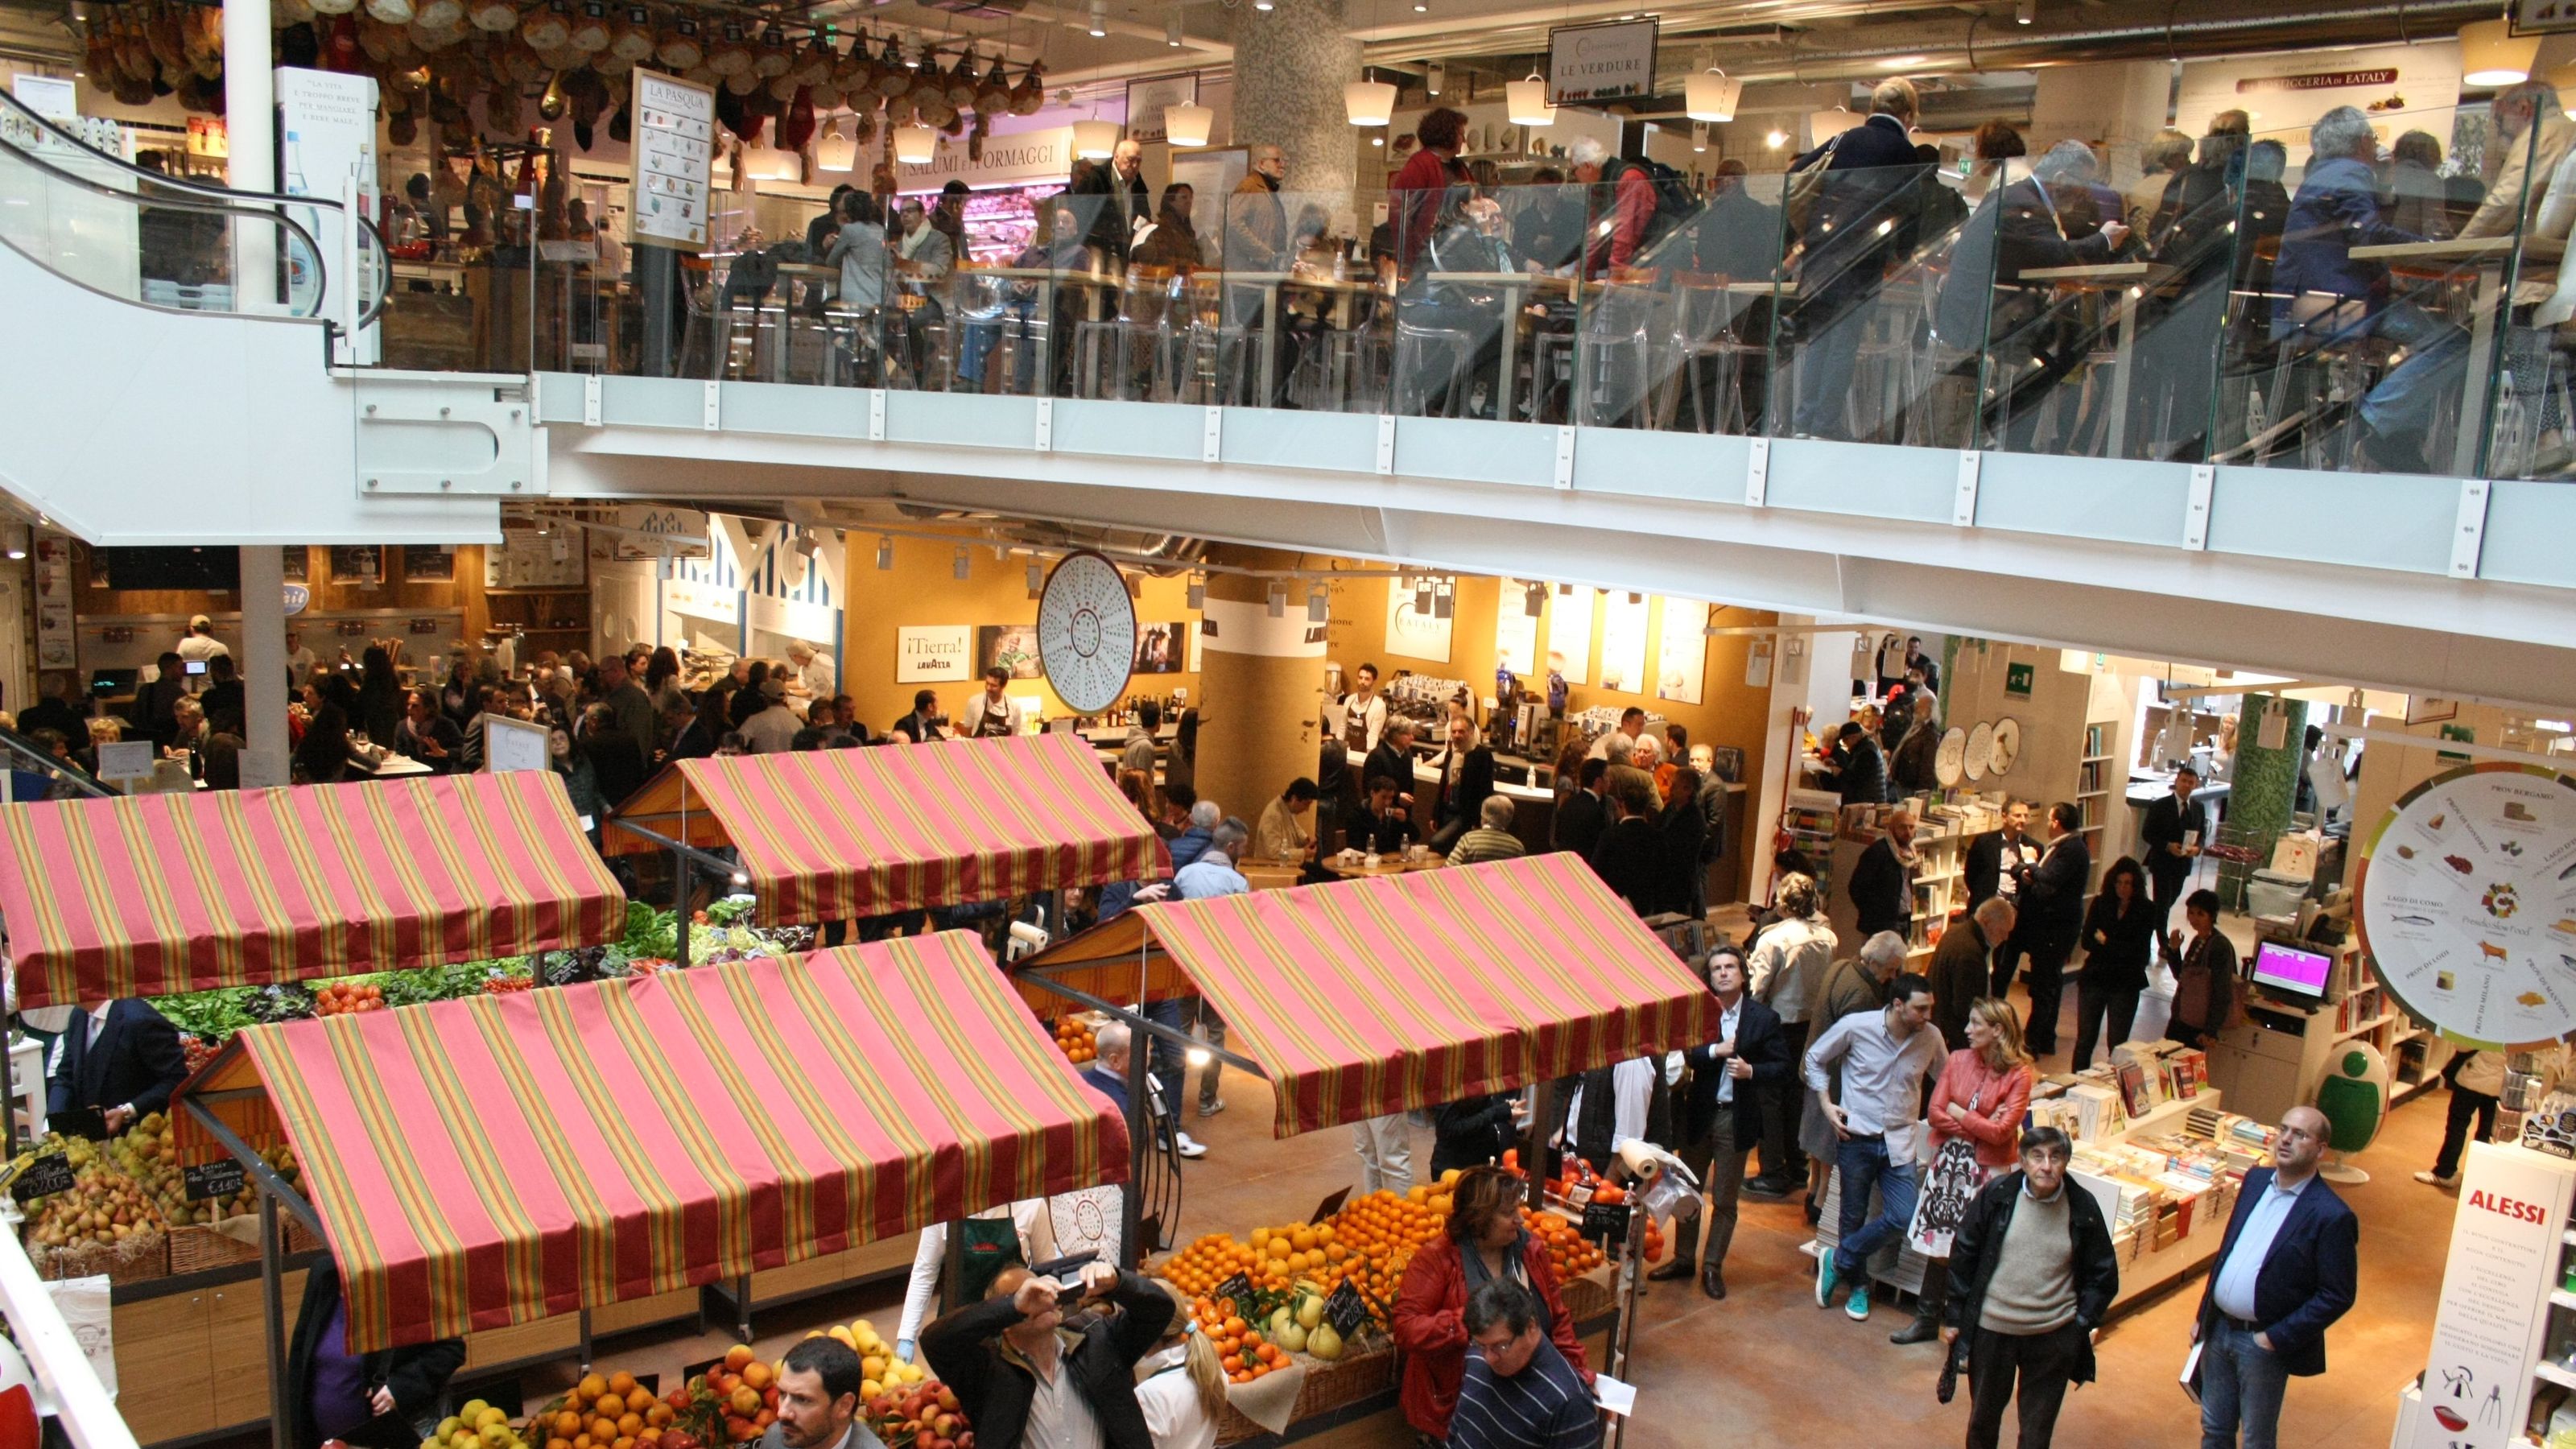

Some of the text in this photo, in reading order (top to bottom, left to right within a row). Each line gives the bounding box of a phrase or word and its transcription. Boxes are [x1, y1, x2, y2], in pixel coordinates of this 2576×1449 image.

[1561, 59, 1642, 77] LE VERDURE
[2345, 72, 2389, 85] EATALY
[650, 84, 663, 98] LA
[666, 88, 704, 109] PASQUA
[909, 155, 958, 176] SALUMI
[283, 590, 305, 605] àit
[907, 637, 961, 654] ¡Tierra!
[2491, 785, 2555, 801] PROV BERGAMO
[2446, 797, 2462, 817] PROV
[2466, 821, 2490, 854] SONDRIO
[2542, 845, 2567, 863] LAGO
[2387, 894, 2444, 908] LAGO DI COMO
[2405, 966, 2424, 980] PROV
[2433, 949, 2450, 964] LODI
[2526, 957, 2540, 975] PROV
[2546, 987, 2570, 1020] MANTOVA
[2475, 1013, 2483, 1034] PROV
[2480, 974, 2491, 1003] MILANO
[2468, 1190, 2545, 1225] ALESSI
